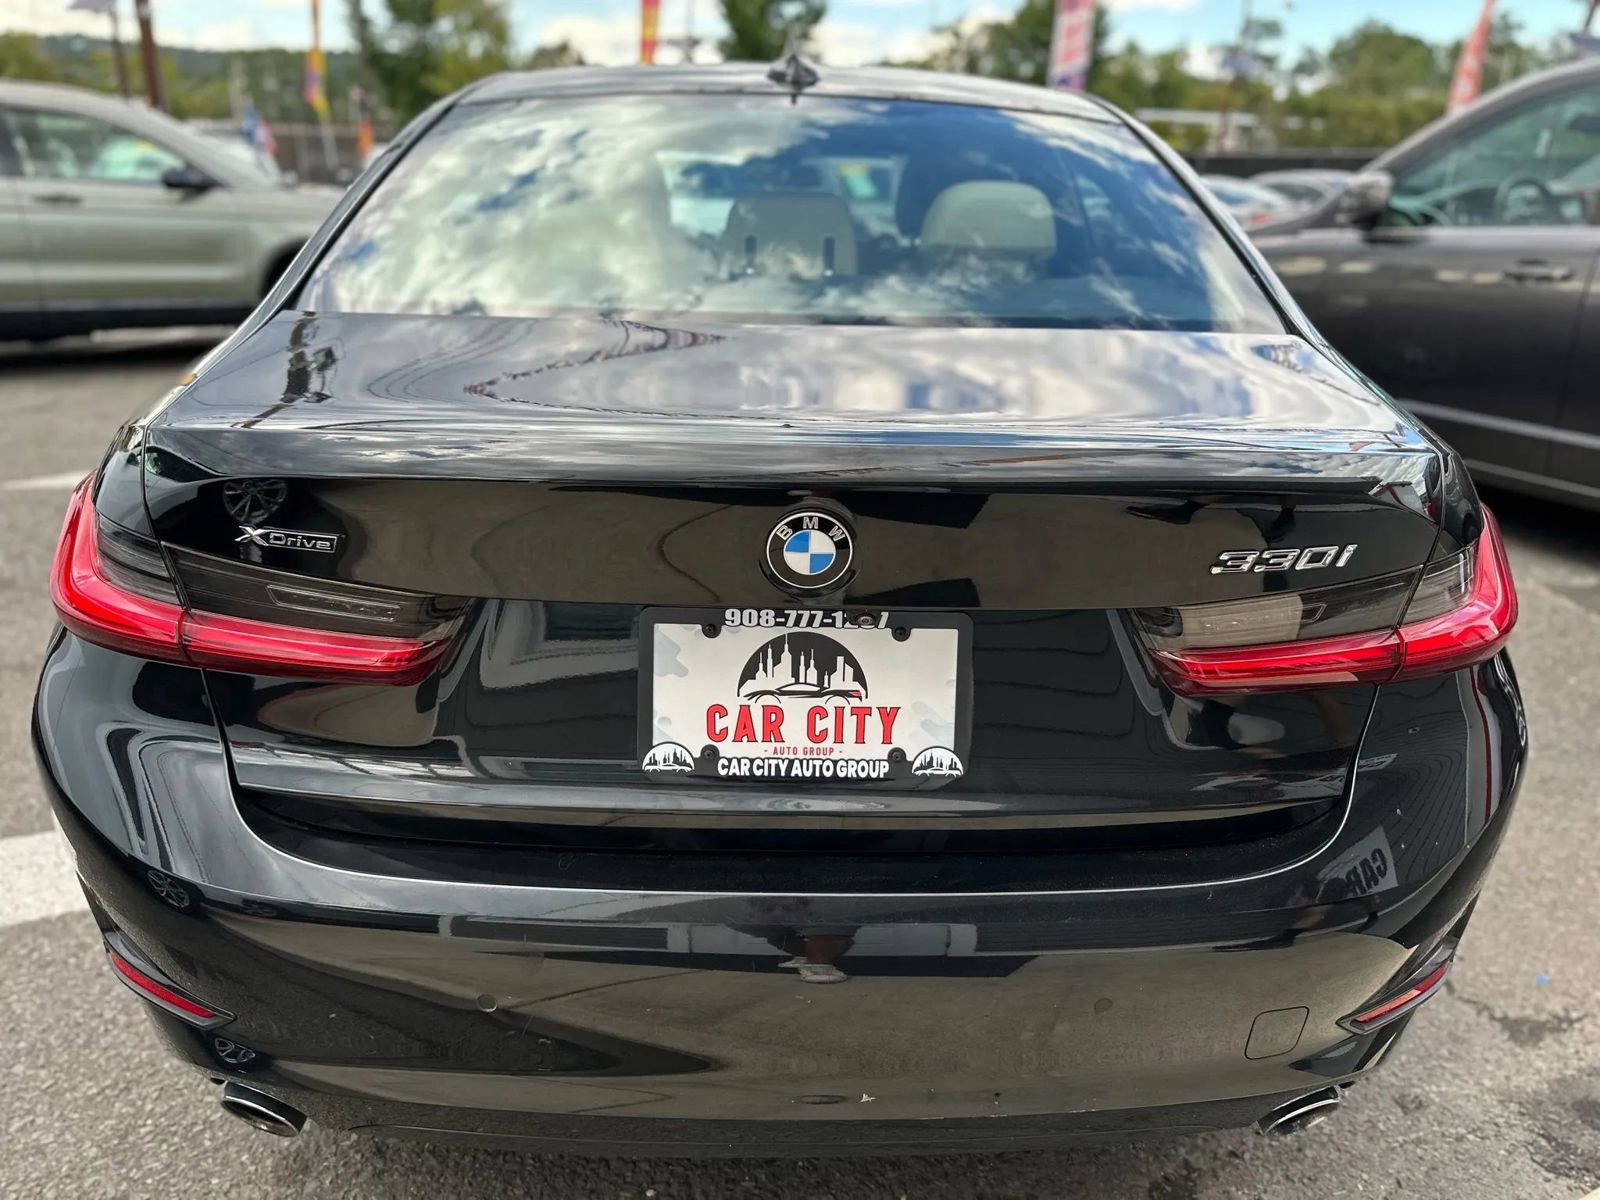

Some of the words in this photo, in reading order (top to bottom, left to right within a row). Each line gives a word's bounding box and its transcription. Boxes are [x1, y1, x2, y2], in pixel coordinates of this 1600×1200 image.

[776, 516, 846, 542] BMW
[1210, 543, 1358, 574] 330i
[724, 608, 889, 629] 908-777-17
[706, 703, 785, 743] CAR
[806, 705, 902, 745] CITY
[773, 746, 798, 756] AUTO
[803, 746, 834, 756] GROUP
[717, 758, 751, 776] CAR
[752, 758, 792, 777] CITY
[791, 759, 837, 778] AUTO
[839, 760, 889, 778] GROUP
